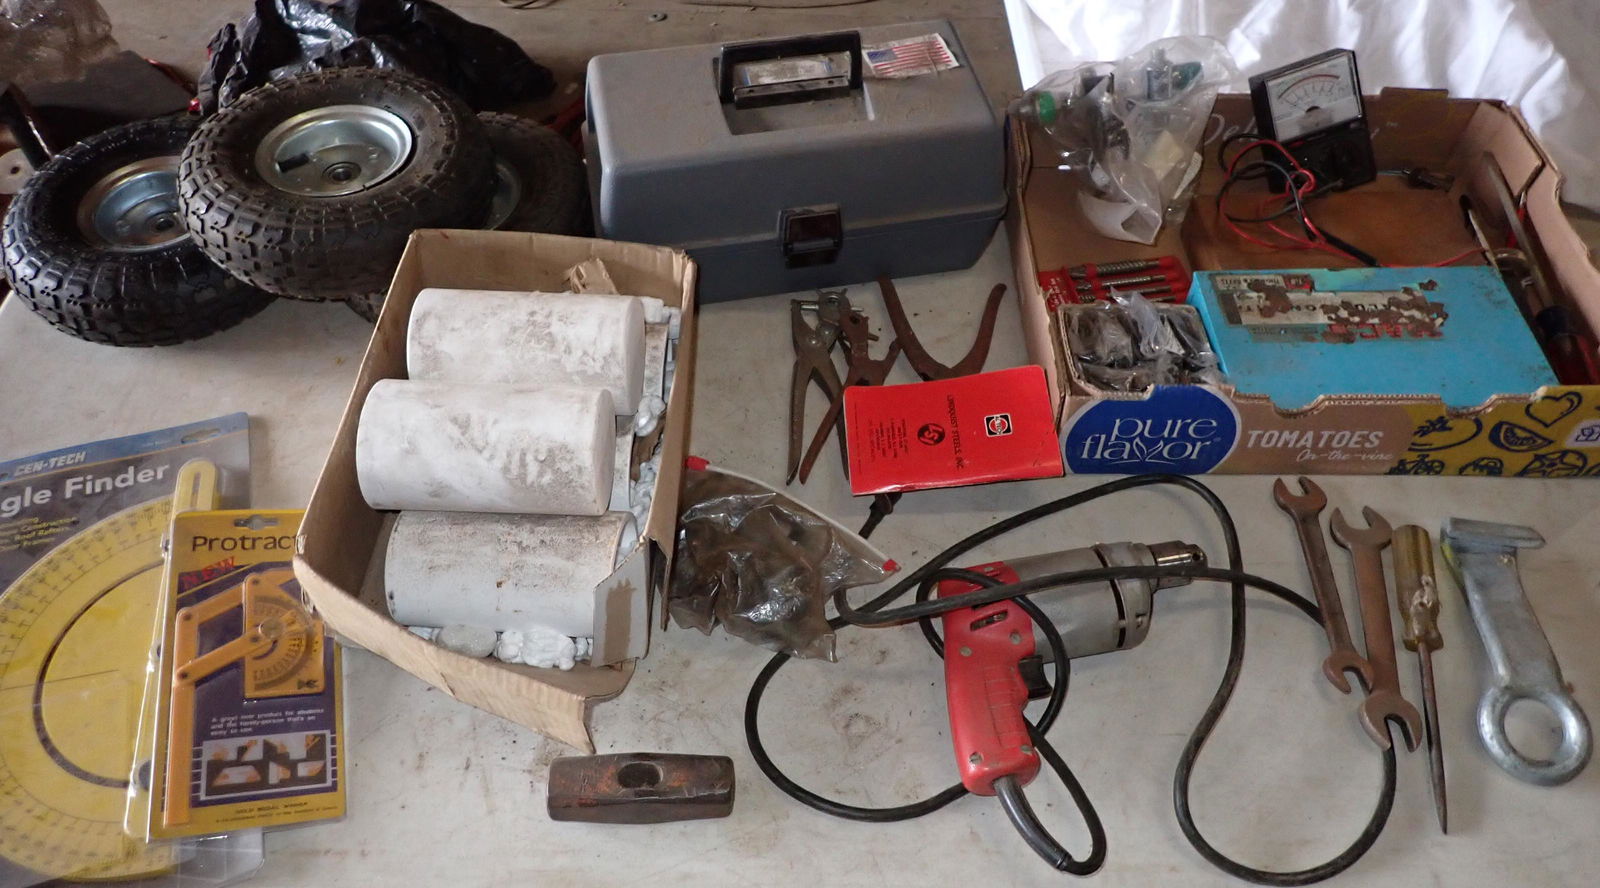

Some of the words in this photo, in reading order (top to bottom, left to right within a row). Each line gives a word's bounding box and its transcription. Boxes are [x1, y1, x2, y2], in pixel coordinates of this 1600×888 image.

[1110, 418, 1217, 442] pure
[1247, 430, 1384, 448] TOMATOES
[1080, 433, 1212, 464] flavor
[14, 452, 86, 476] CEN-TECH
[65, 464, 170, 499] Finder
[192, 535, 298, 551] Protrac
[182, 556, 235, 590] NEW
